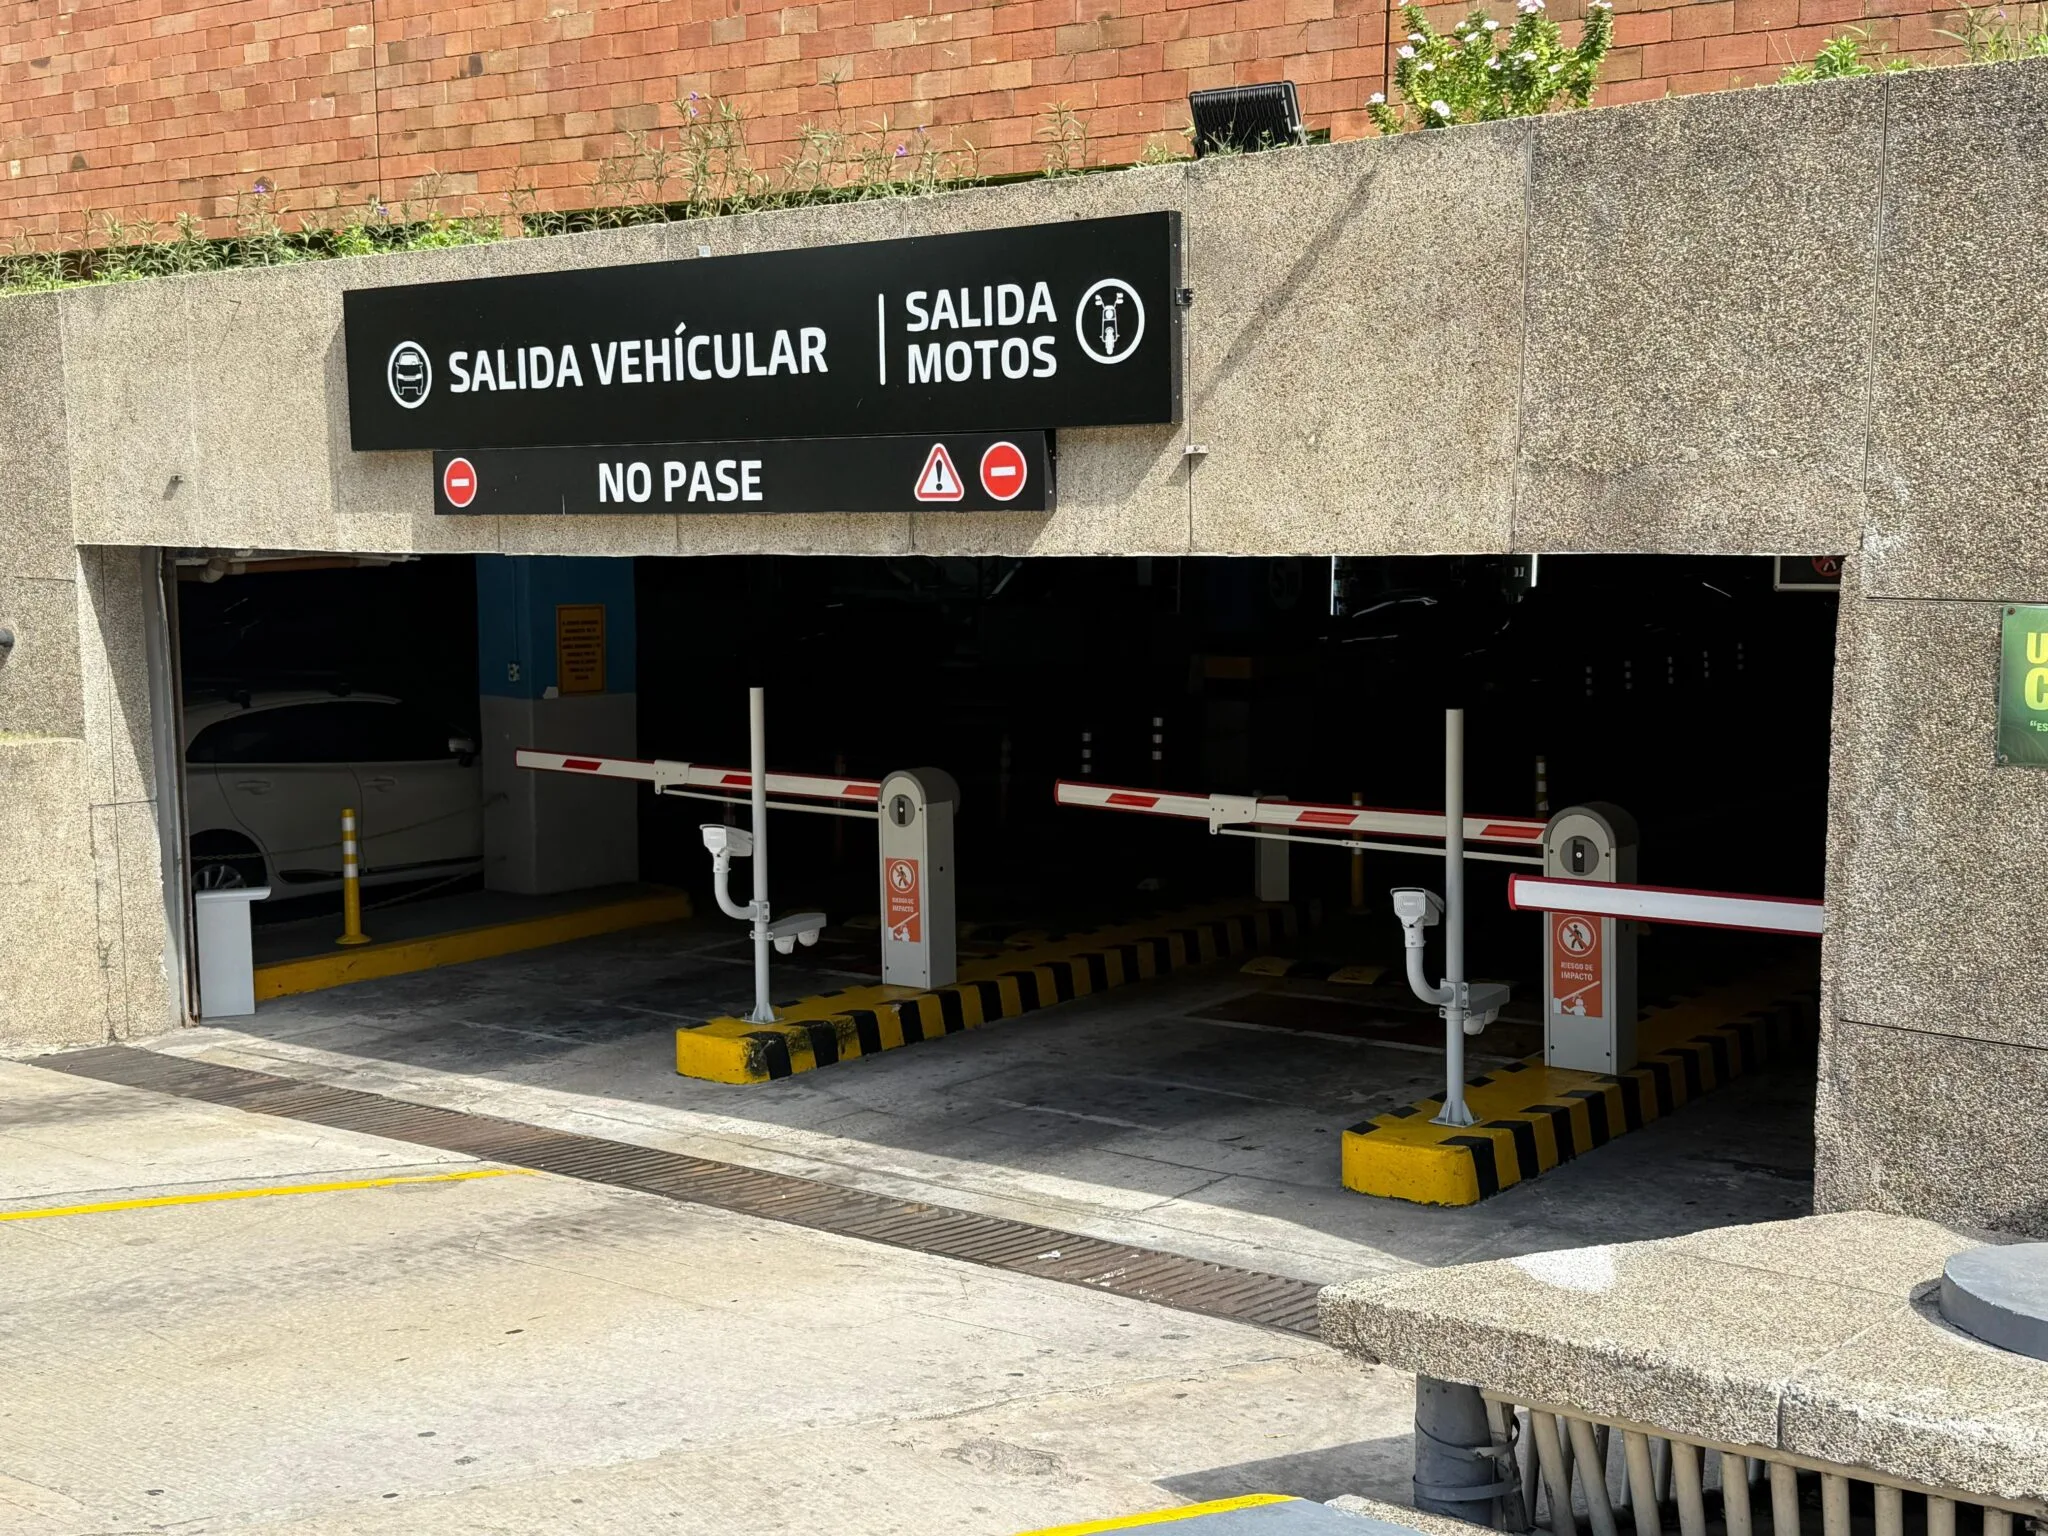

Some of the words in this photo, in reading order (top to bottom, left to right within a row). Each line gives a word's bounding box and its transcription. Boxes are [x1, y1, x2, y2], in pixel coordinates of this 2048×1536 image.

[906, 282, 1057, 332] SALIDA
[449, 345, 584, 393] SALIDA
[591, 322, 829, 386] VEHÍCULAR
[907, 336, 1057, 384] MOTOS
[598, 461, 652, 503] NO
[663, 459, 763, 503] PASE
[1560, 961, 1583, 970] RIESGO
[1561, 971, 1593, 981] IMPACTO
